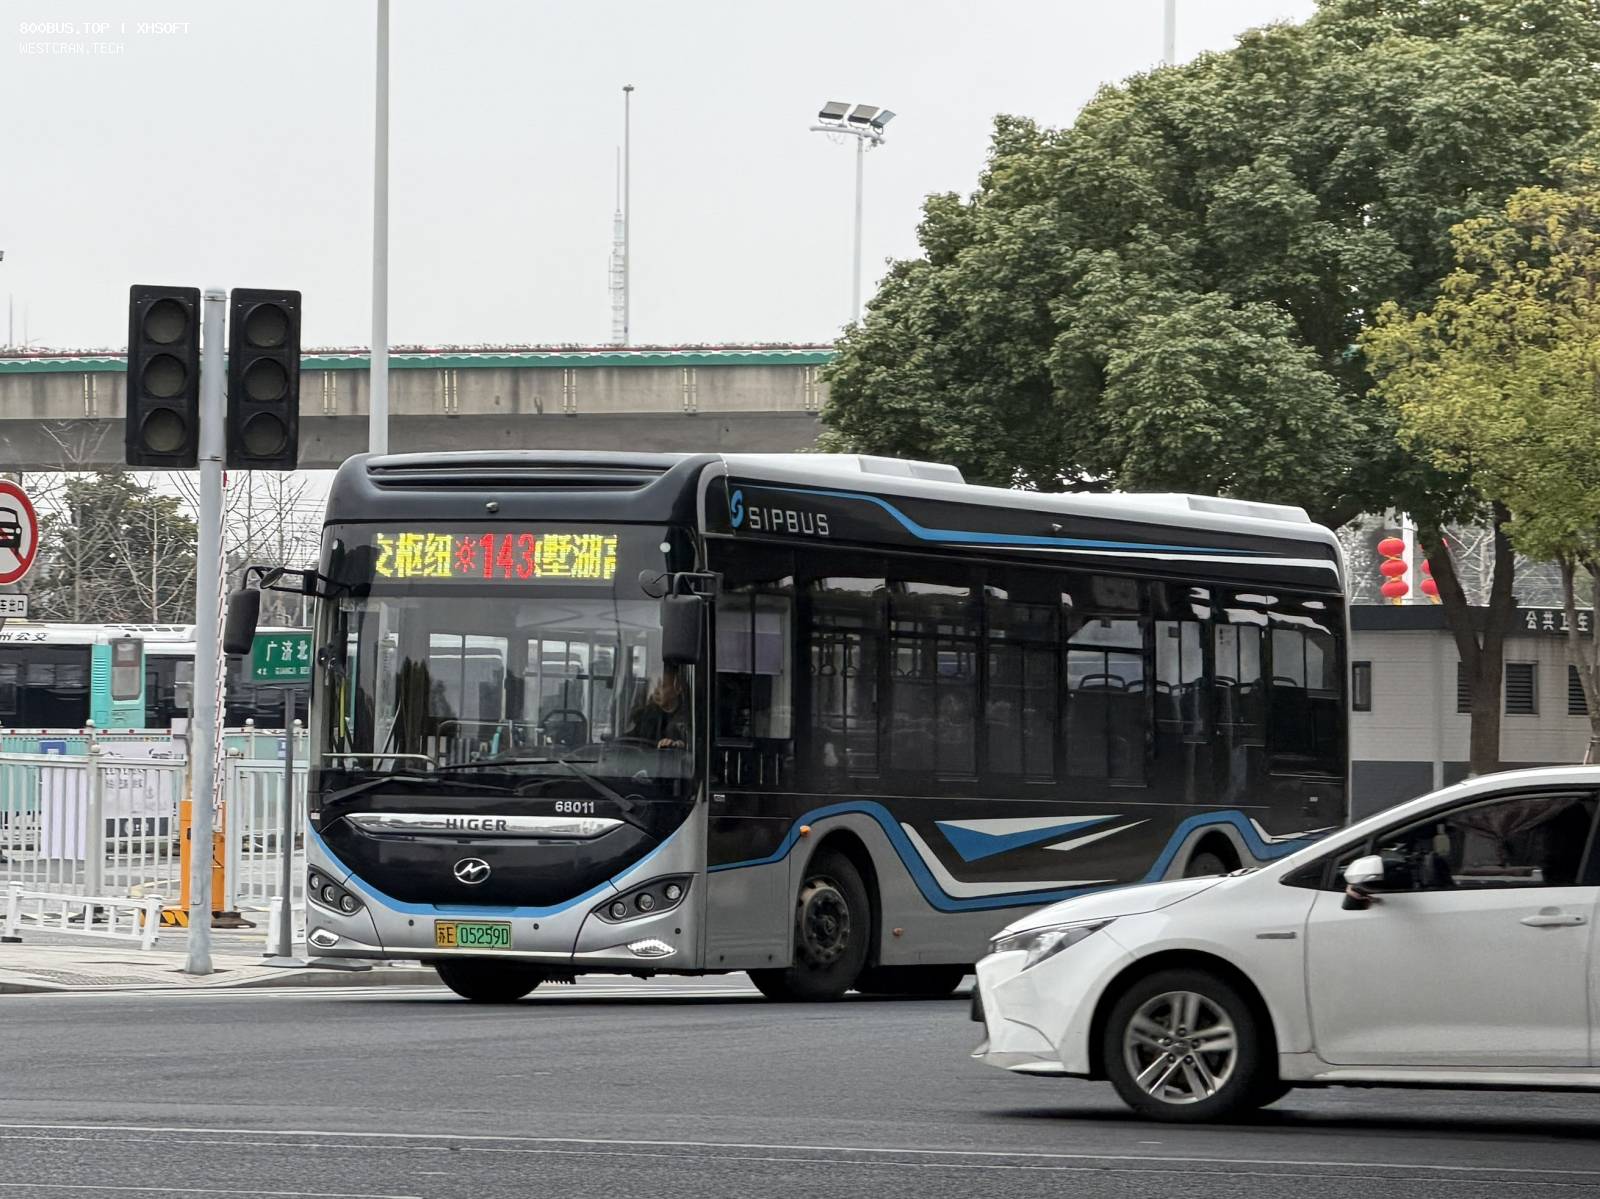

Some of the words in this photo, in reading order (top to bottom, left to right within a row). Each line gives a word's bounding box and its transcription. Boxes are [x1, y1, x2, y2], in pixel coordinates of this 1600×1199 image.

[748, 506, 830, 536] SIPBUS
[479, 532, 535, 579] 143
[555, 801, 595, 814] 68011
[445, 818, 508, 832] HIGER
